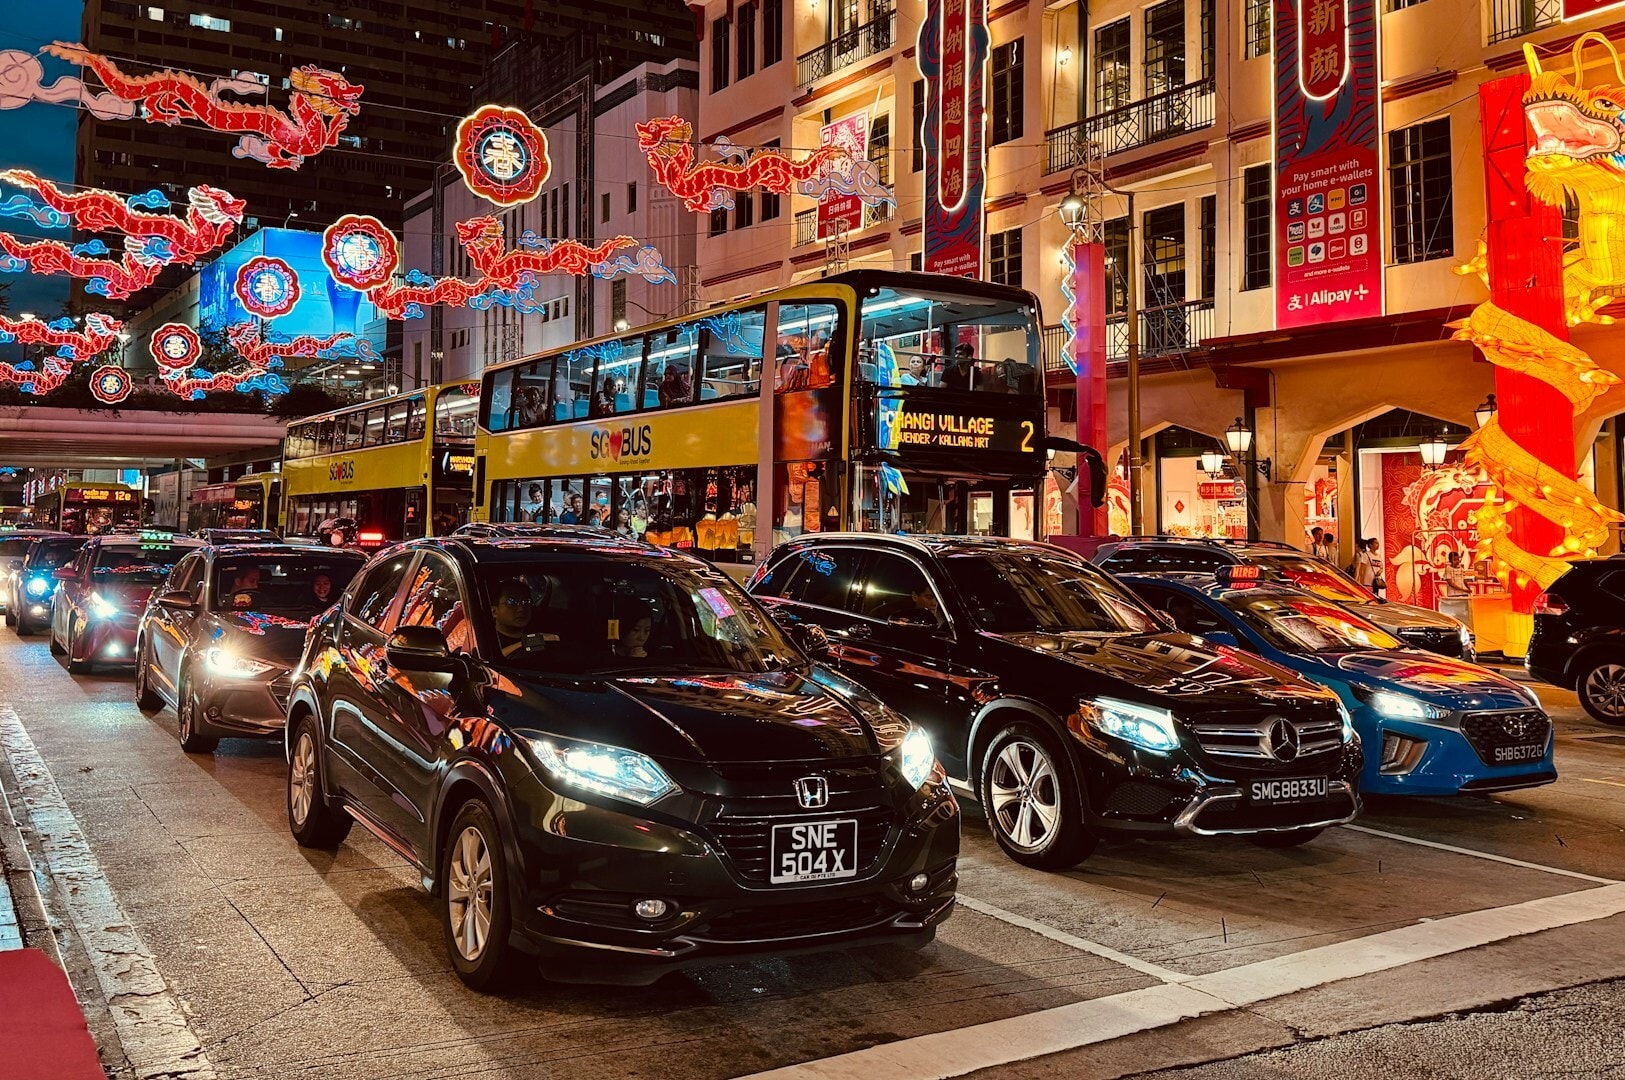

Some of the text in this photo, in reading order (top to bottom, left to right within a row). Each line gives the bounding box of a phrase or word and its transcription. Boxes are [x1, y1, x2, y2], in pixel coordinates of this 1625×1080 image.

[482, 134, 524, 178] 春
[1293, 159, 1359, 183] Pay smart with
[1281, 168, 1373, 199] your home e-wallets
[944, 257, 959, 266] smart
[959, 253, 971, 262] with
[886, 411, 994, 435] CHANGI VILLAGE
[890, 431, 931, 445] LAVENDER
[938, 435, 975, 447] KALLANG
[974, 437, 990, 449] MRT
[1020, 420, 1035, 452] 2
[115, 491, 131, 500] 12e
[1232, 567, 1259, 578] HIRED
[1495, 744, 1542, 761] SHB6372G
[1252, 779, 1326, 800] SMG8833U
[791, 824, 837, 850] SNE
[781, 849, 846, 876] 504X
